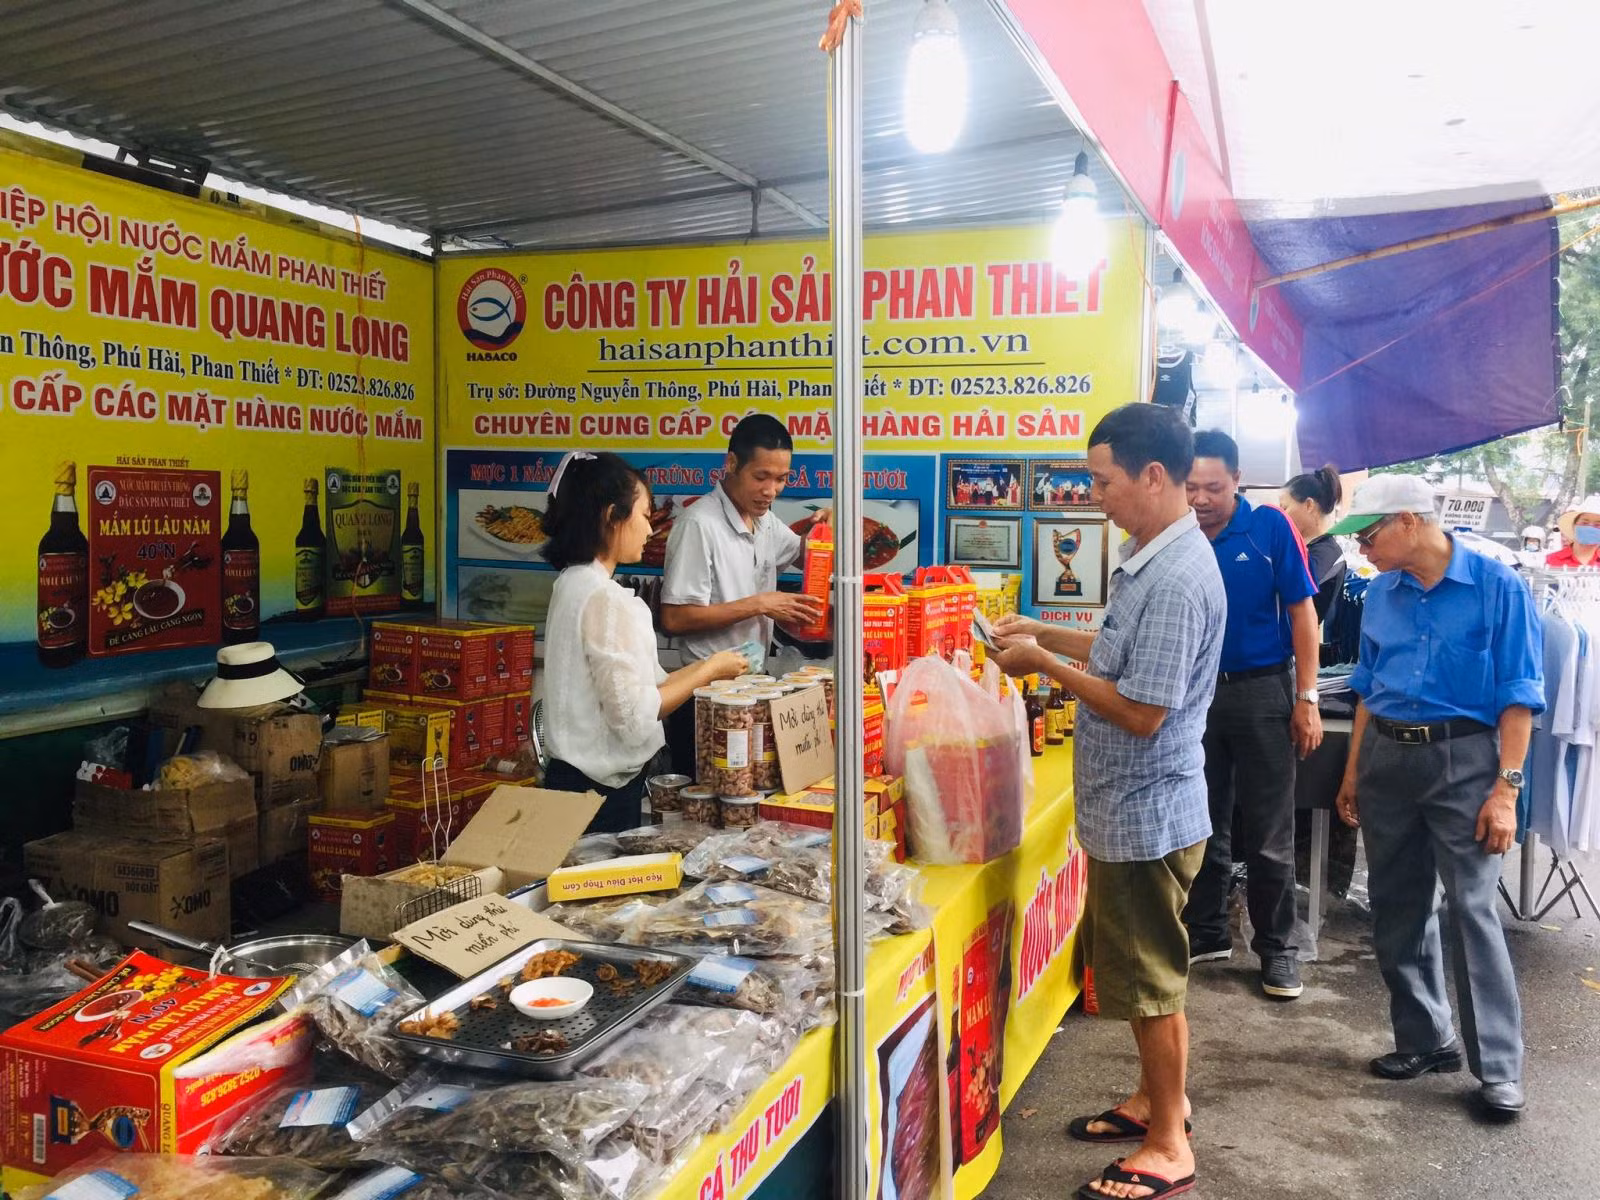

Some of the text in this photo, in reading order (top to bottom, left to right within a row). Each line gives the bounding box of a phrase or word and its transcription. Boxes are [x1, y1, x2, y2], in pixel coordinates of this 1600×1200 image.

[56, 205, 109, 243] HỘI
[121, 219, 202, 260] NƯỚC
[210, 236, 271, 275] MẮM
[279, 257, 335, 289] PHAN
[341, 271, 386, 300] THIẾT
[0, 240, 409, 362] ỚC MẮM QUANG LONG
[544, 273, 635, 330] CÔNG
[647, 279, 687, 326] TY
[698, 259, 757, 325] HẢI
[863, 266, 973, 320] PHAN
[21, 331, 96, 368] Thông,
[103, 342, 141, 368] Phú
[148, 348, 185, 377] Hài,
[191, 354, 234, 379] Phan
[239, 359, 280, 384] Thiết
[297, 368, 323, 389] ĐT:
[328, 372, 415, 400] 02523.826.826
[599, 332, 1029, 365] haisanphanthit.com.vn
[467, 382, 493, 401] Trụ
[497, 381, 519, 399] sở:
[525, 382, 577, 402] Đường
[581, 379, 640, 402] Nguyễn
[645, 379, 702, 402] Thông,
[708, 380, 740, 398] Phú
[746, 380, 782, 400] Hài,
[788, 379, 832, 397] Phan
[909, 378, 944, 397] ĐT:
[951, 375, 1091, 397] 02523.826.826
[13, 373, 422, 439] CẤP CÁC MẶT HÀNG NƯỚC MẮM
[474, 412, 570, 435] CHUYÊN
[579, 415, 650, 435] CUNG
[658, 409, 711, 435] CẤP
[788, 411, 832, 441] MẶ
[863, 411, 940, 437] HÀNG
[953, 409, 1005, 437] HẢI
[1017, 408, 1080, 437] SẢN
[511, 466, 518, 482] 1
[523, 457, 558, 482] NẮN
[100, 510, 211, 536] MẮM LÚ LÂU NĂM
[1041, 611, 1093, 624] DỊCH VỤ
[411, 926, 459, 949] Mời
[455, 914, 495, 929] dùng
[1018, 870, 1052, 1001] NƯỚC
[148, 1012, 187, 1031] LÂU
[110, 1030, 154, 1053] NĂM
[700, 1079, 801, 1200] CÁ THU TƯƠI
